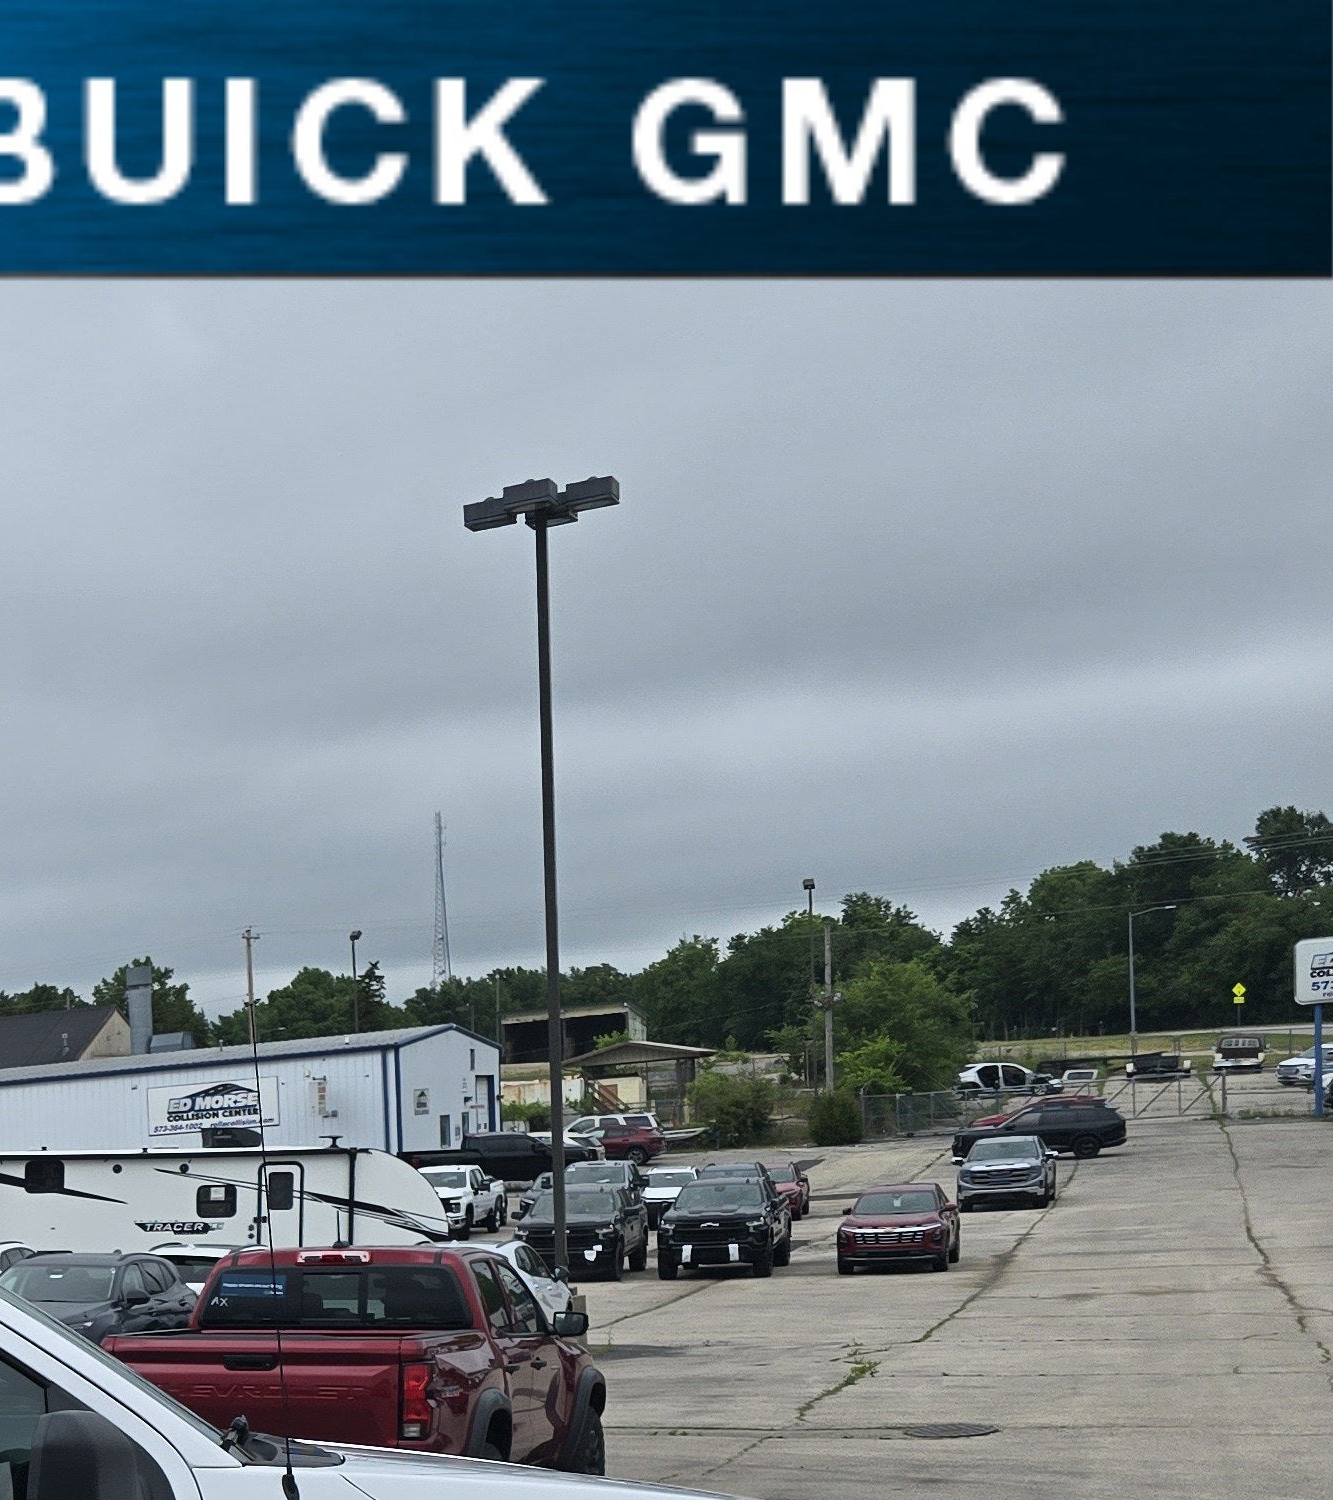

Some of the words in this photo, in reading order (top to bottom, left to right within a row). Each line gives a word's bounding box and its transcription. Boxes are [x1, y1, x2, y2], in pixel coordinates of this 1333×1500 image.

[168, 1098, 192, 1113] ED
[194, 1092, 259, 1111] MORSE
[167, 1111, 219, 1122] COLLISION
[222, 1107, 259, 1118] CENTER
[144, 1222, 205, 1232] TRACER
